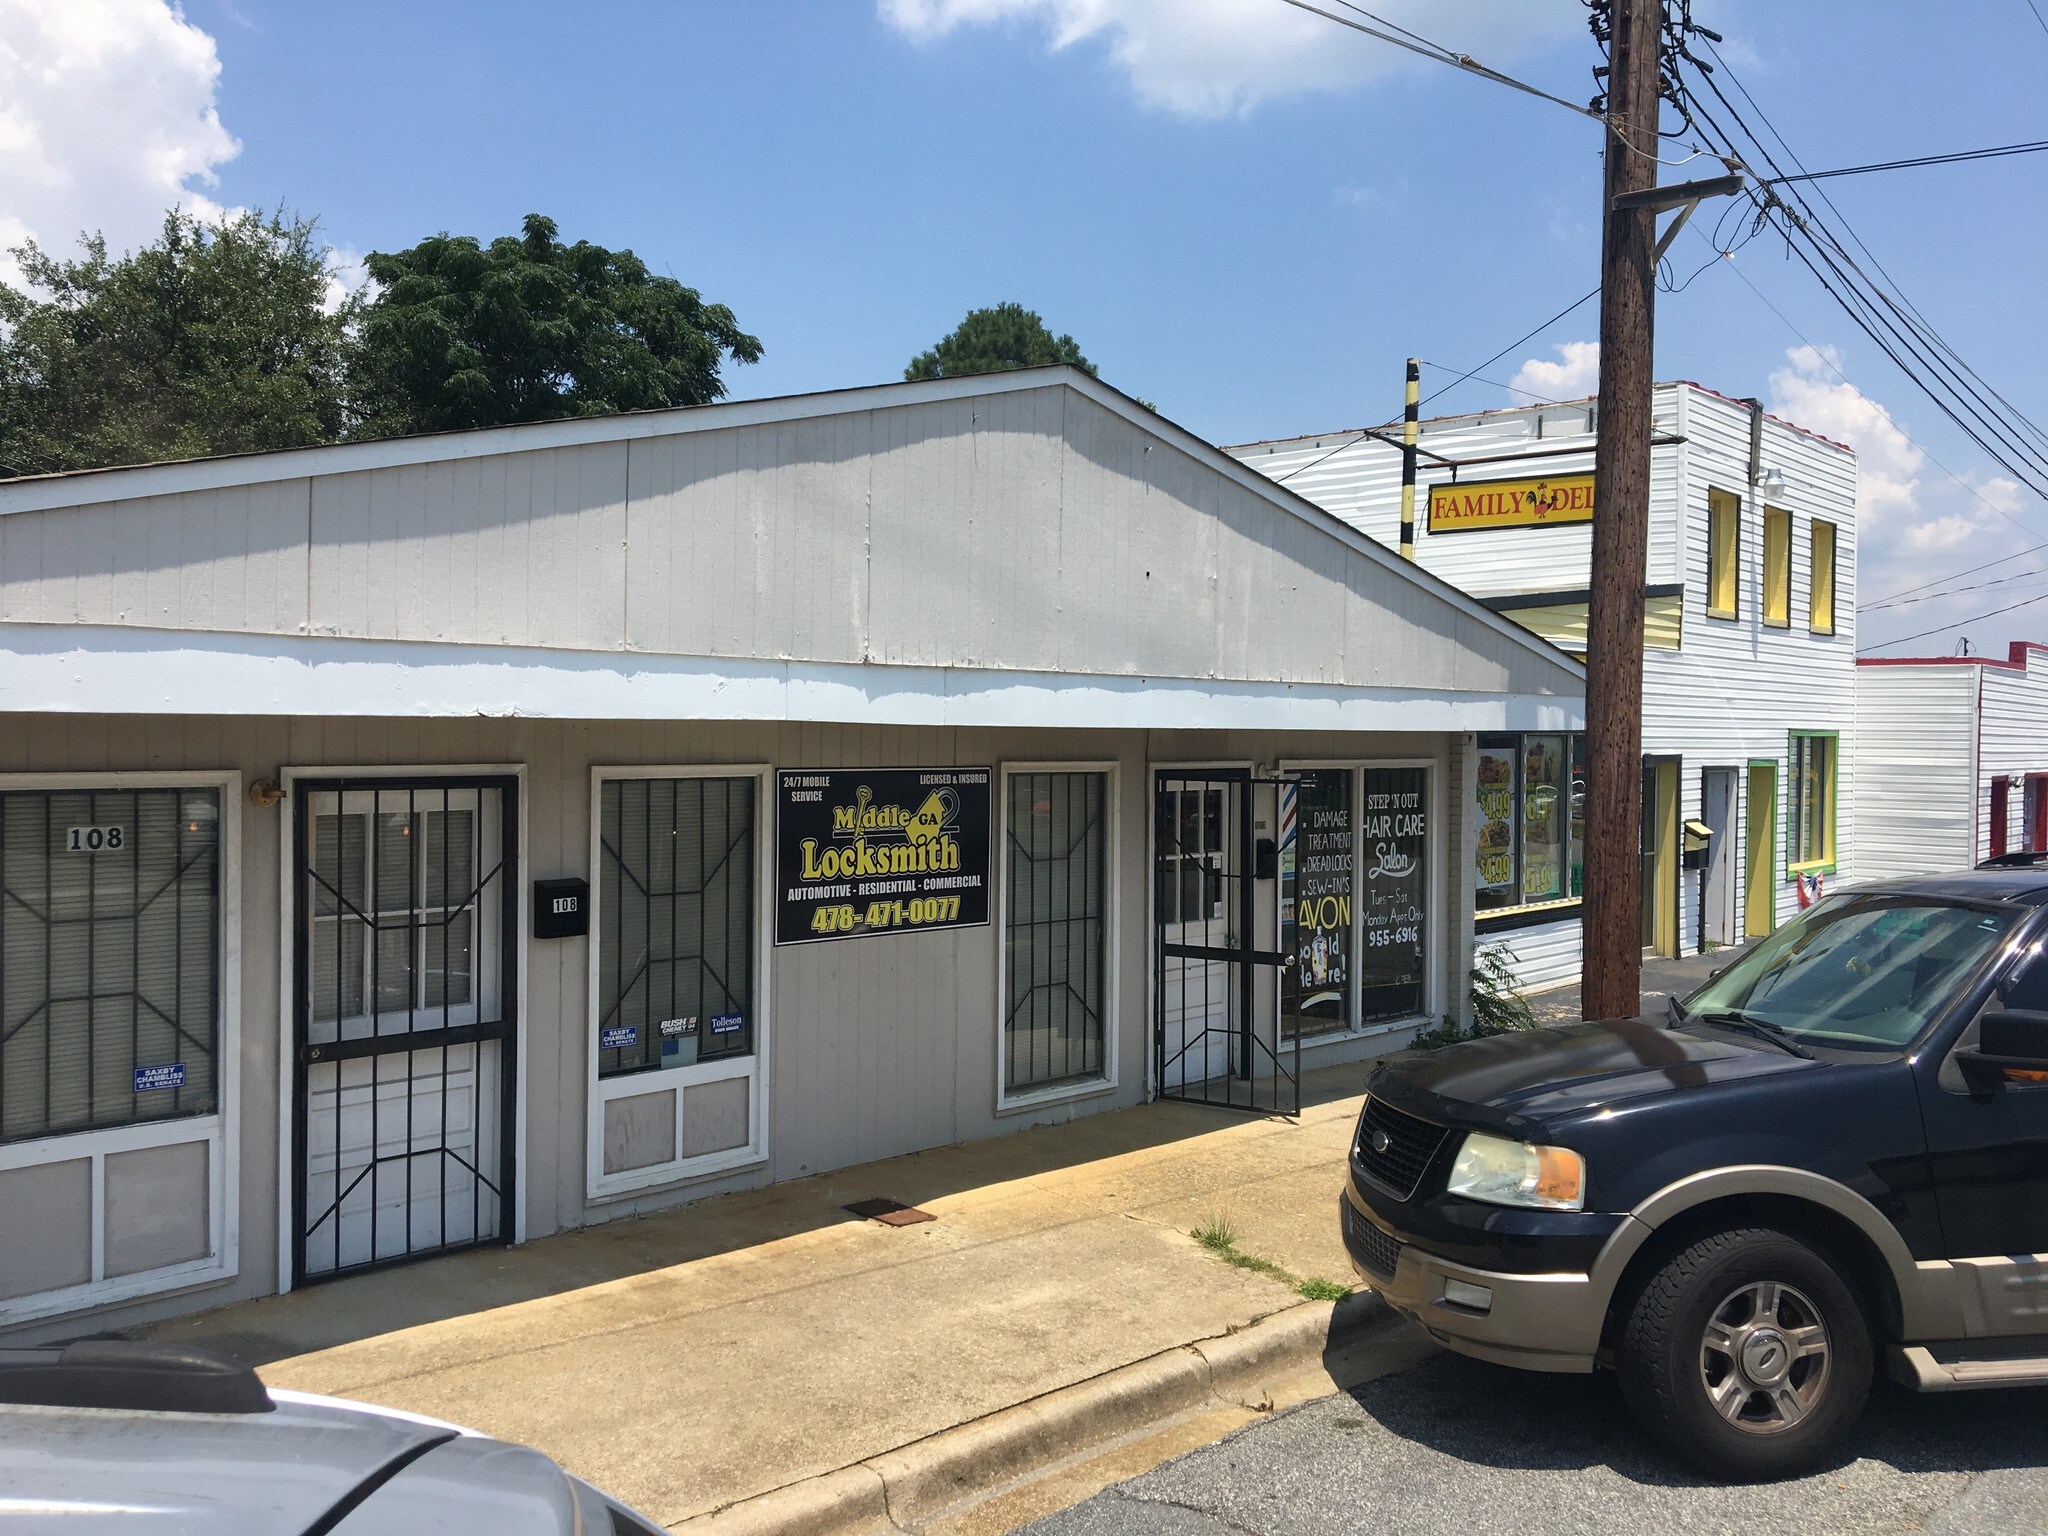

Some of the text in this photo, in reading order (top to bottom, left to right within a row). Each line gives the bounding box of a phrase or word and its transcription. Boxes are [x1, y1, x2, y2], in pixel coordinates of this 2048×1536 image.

[1434, 490, 1526, 519] FAMILY
[783, 776, 830, 788] 24/7 MOBILE
[920, 773, 987, 785] LICENSED & INSURED
[791, 790, 823, 802] SERVICE
[1368, 794, 1390, 810] STEP
[1401, 793, 1419, 809] OUT
[834, 788, 912, 835] Middle
[1480, 790, 1511, 820] $4.99
[918, 813, 939, 826] GA
[1314, 810, 1348, 828] DAMAGE
[1362, 814, 1425, 838] HAIR CARE
[71, 827, 122, 850] 108
[1308, 832, 1352, 850] TREATMENT
[801, 834, 960, 880] Locksmith
[1368, 842, 1417, 880] Salon
[1480, 854, 1511, 884] $4.99
[787, 884, 852, 902] AUTOMOTIVE
[858, 879, 917, 896] RESIDENTIAL
[923, 875, 982, 891] COMMERCIAL
[1370, 889, 1386, 905] Tues
[555, 898, 576, 912] 108
[1299, 896, 1351, 930] AVON
[1369, 925, 1418, 947] 955-6916
[660, 1017, 688, 1029] BUSH
[711, 1016, 742, 1028] Tolleson
[603, 1033, 636, 1042] CHAMBLISS
[137, 1072, 183, 1084] CHAMBLISS
[144, 1067, 175, 1077] SAXBY
[154, 1078, 181, 1087] SENATE
